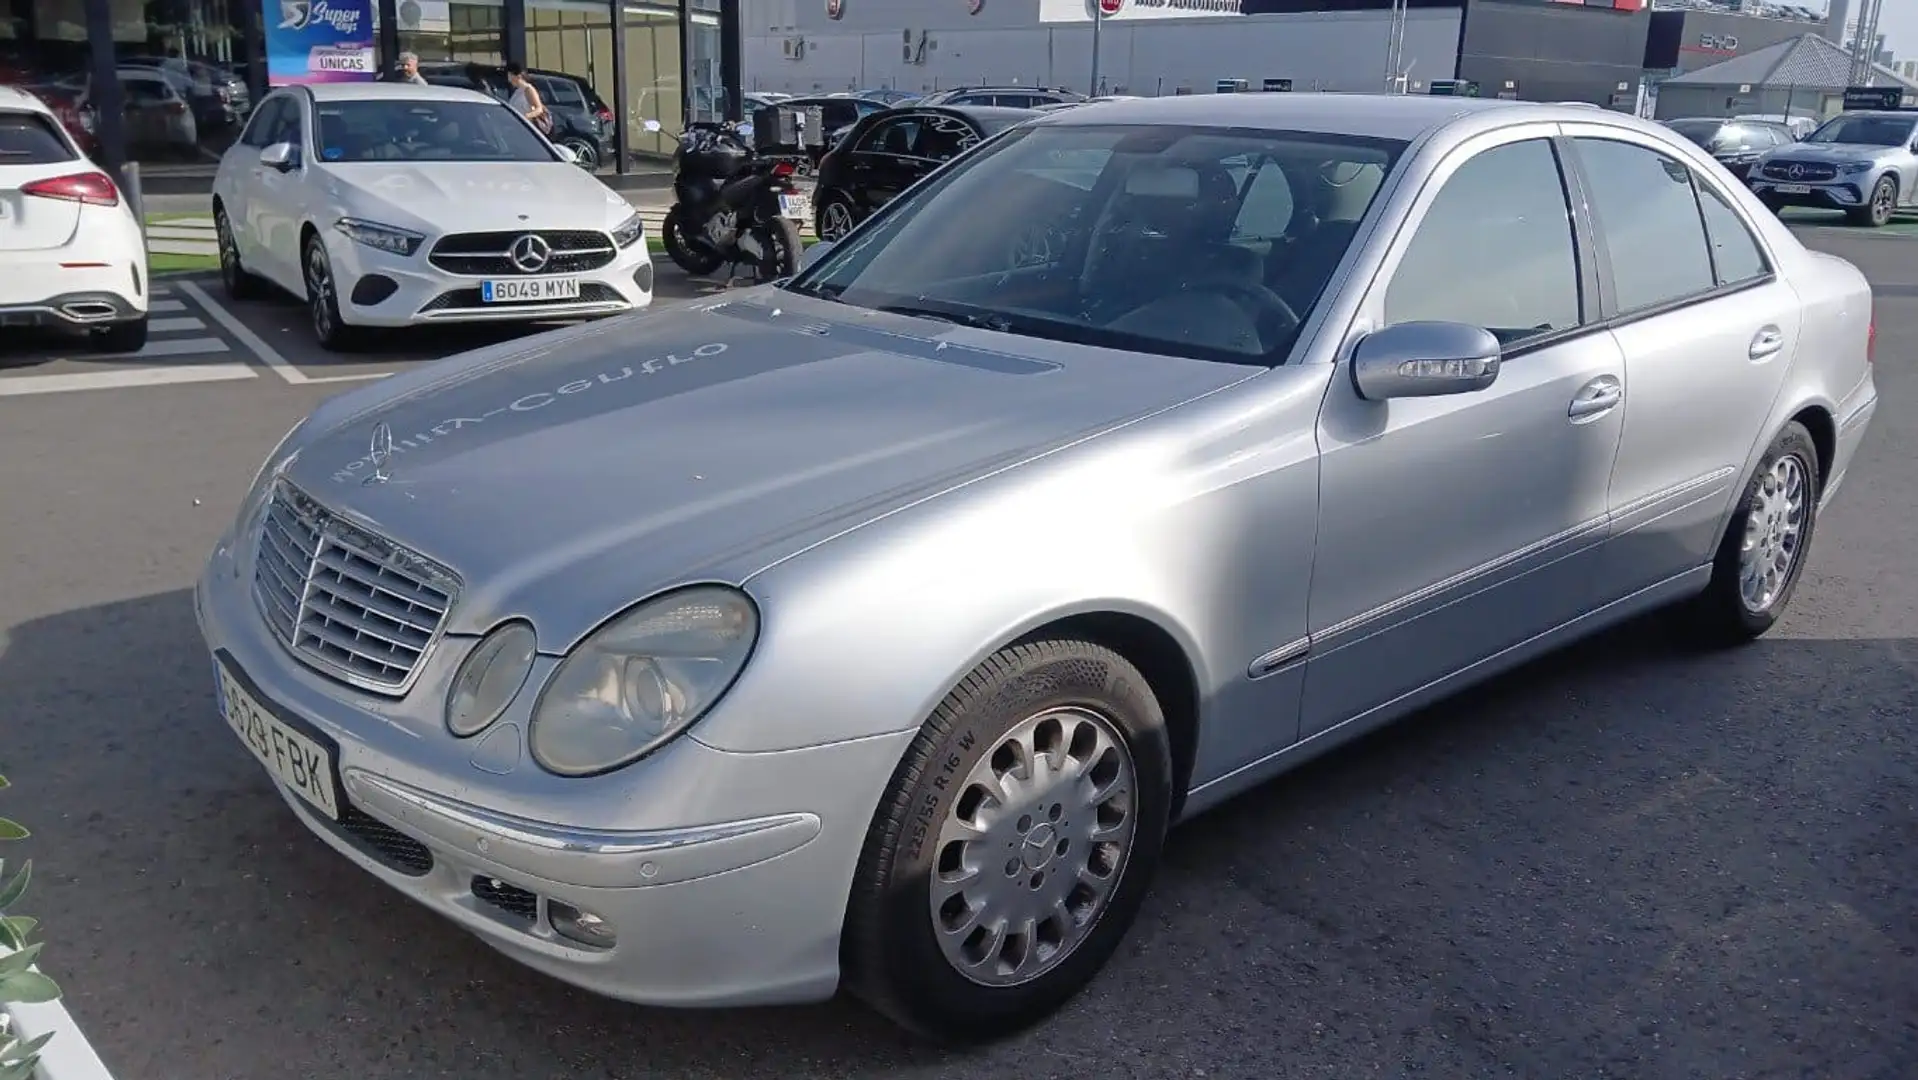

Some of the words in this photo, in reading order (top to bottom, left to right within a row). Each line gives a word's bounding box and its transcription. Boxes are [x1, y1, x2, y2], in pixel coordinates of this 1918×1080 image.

[310, 1, 361, 26] Super
[496, 281, 540, 299] 6049
[546, 278, 577, 297] MYN
[271, 725, 328, 804] FBK
[910, 793, 938, 860] 225/55
[934, 776, 950, 791] R
[943, 753, 961, 774] 16
[958, 730, 976, 751] W
